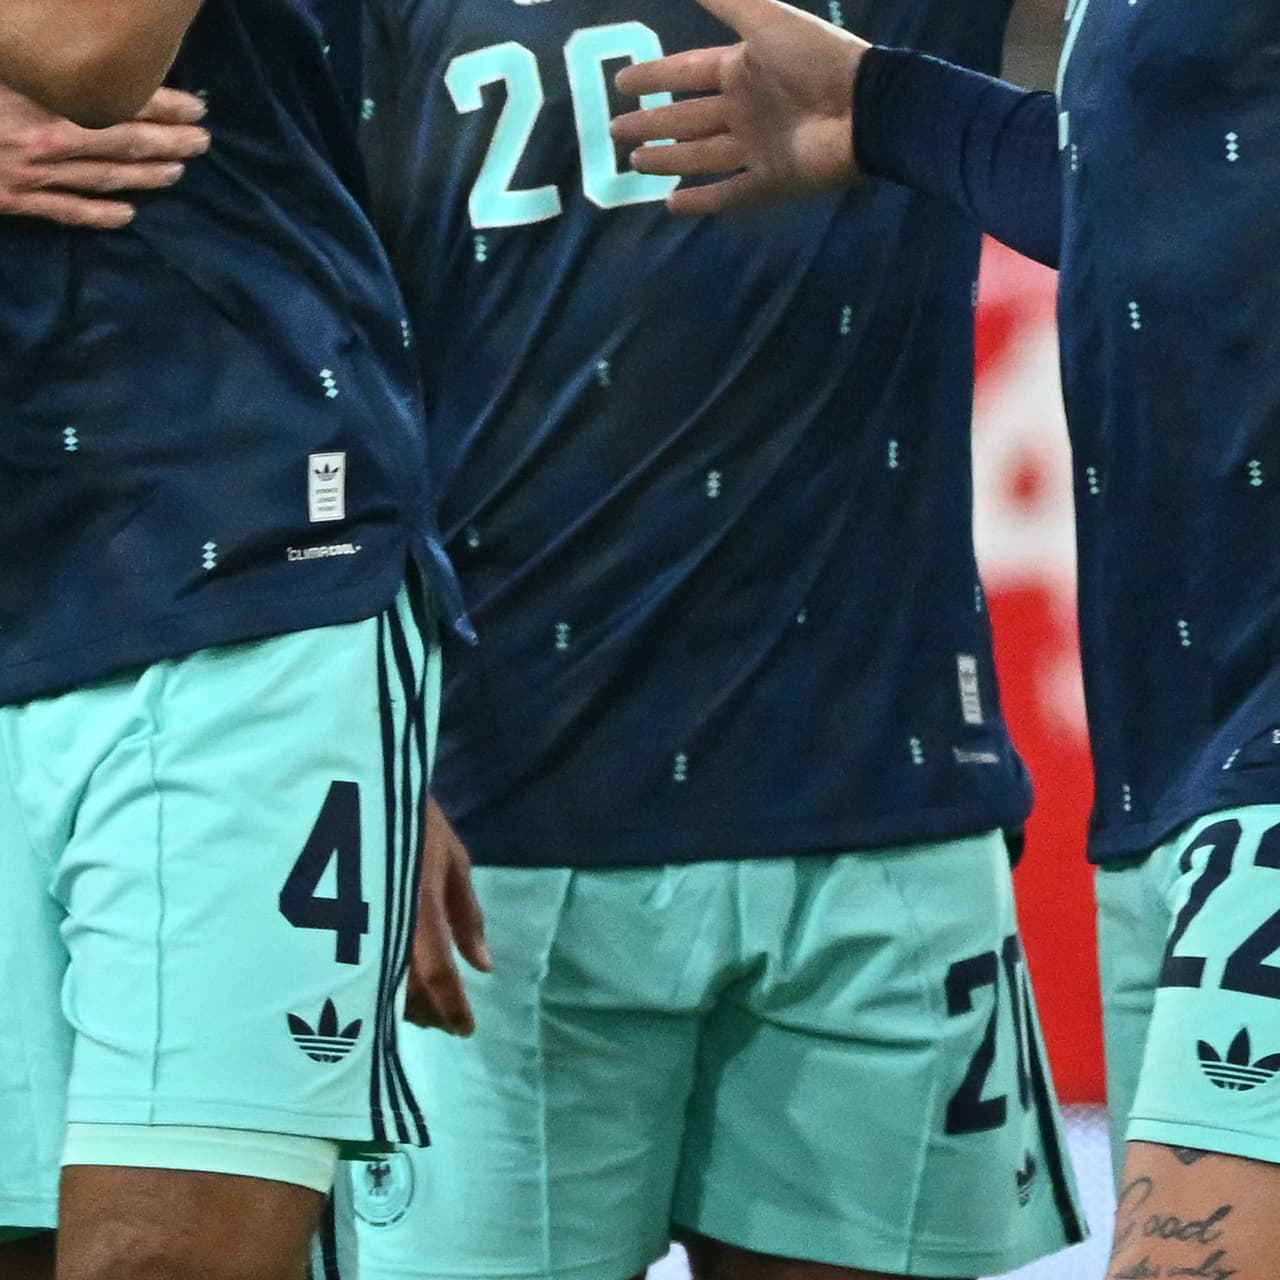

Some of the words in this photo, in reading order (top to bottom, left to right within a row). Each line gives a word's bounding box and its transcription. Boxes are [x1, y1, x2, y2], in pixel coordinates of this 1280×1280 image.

[444, 20, 682, 228] 20
[278, 779, 370, 966] 4
[944, 932, 1032, 1136] 2
